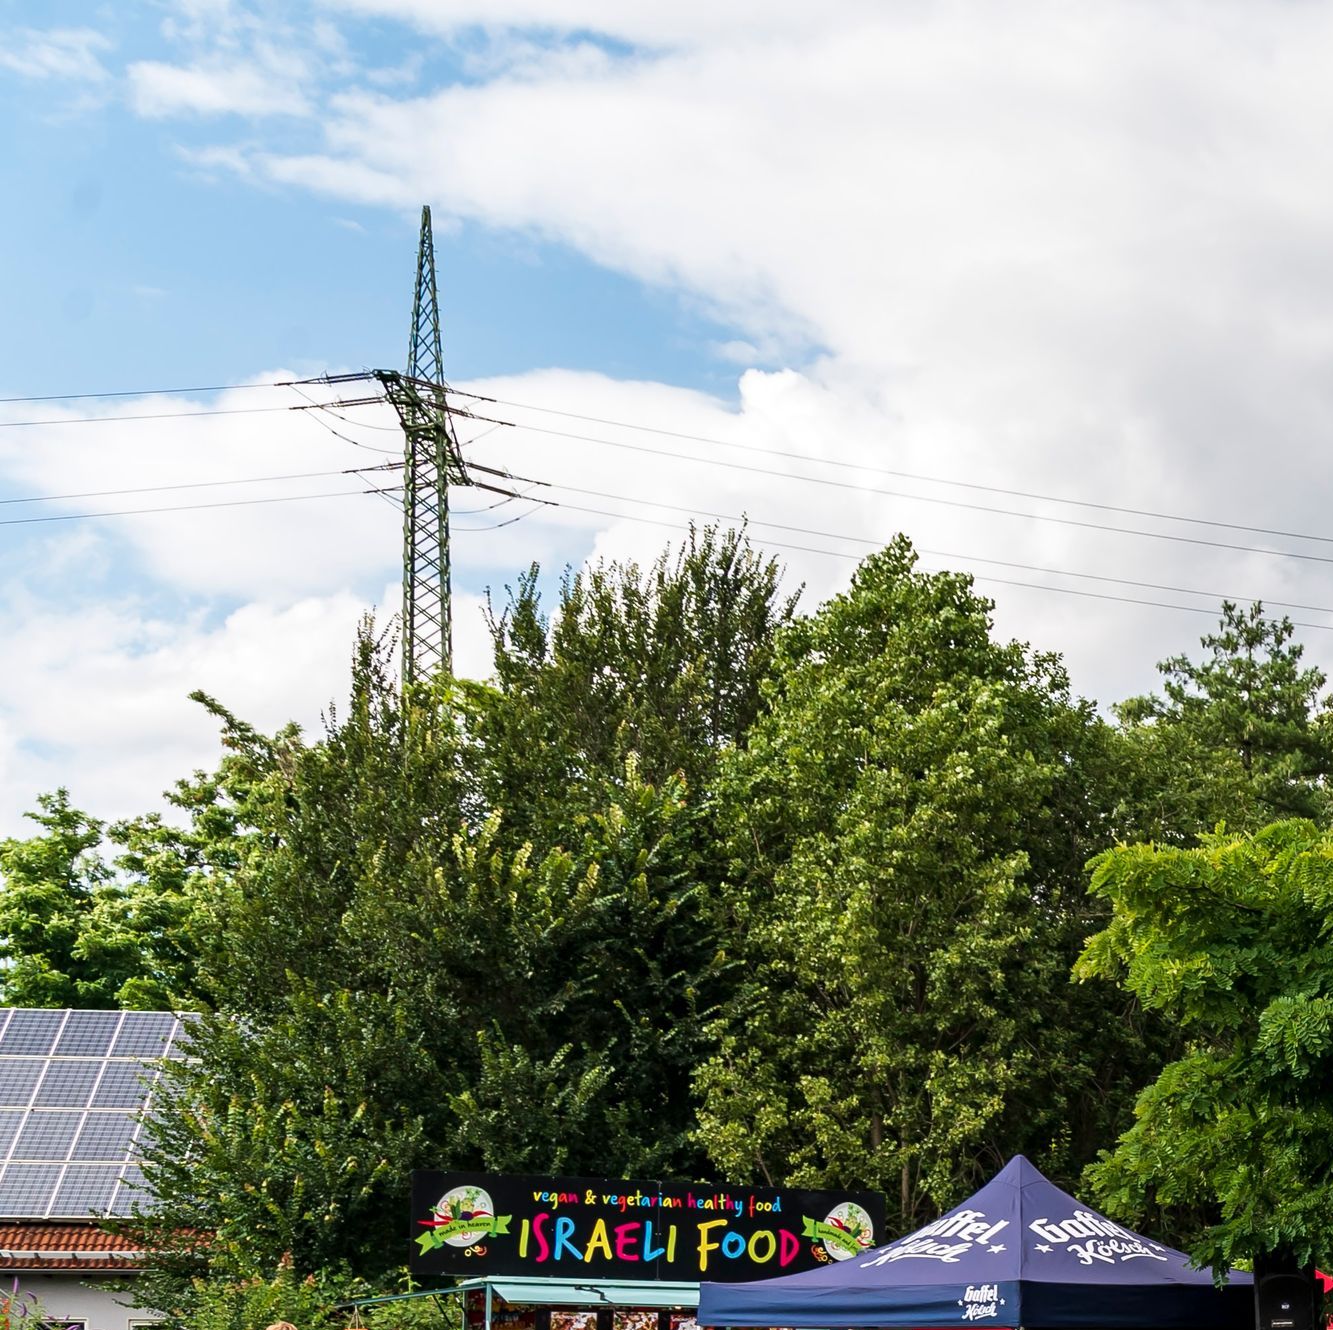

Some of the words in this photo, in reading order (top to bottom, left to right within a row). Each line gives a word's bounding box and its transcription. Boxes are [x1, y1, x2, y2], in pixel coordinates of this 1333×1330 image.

[533, 1190, 579, 1210] vegan
[584, 1189, 596, 1205] &
[602, 1190, 682, 1212] vegetarian
[687, 1192, 743, 1217] healthy
[748, 1196, 781, 1218] food
[439, 1225, 457, 1237] made
[1028, 1209, 1143, 1244] Gaffel
[519, 1213, 677, 1263] ISRAELI
[697, 1219, 800, 1272] FOOD
[1066, 1239, 1167, 1265] Kölsch
[963, 1284, 999, 1302] Gaffel
[961, 1302, 998, 1321] Kölsch
